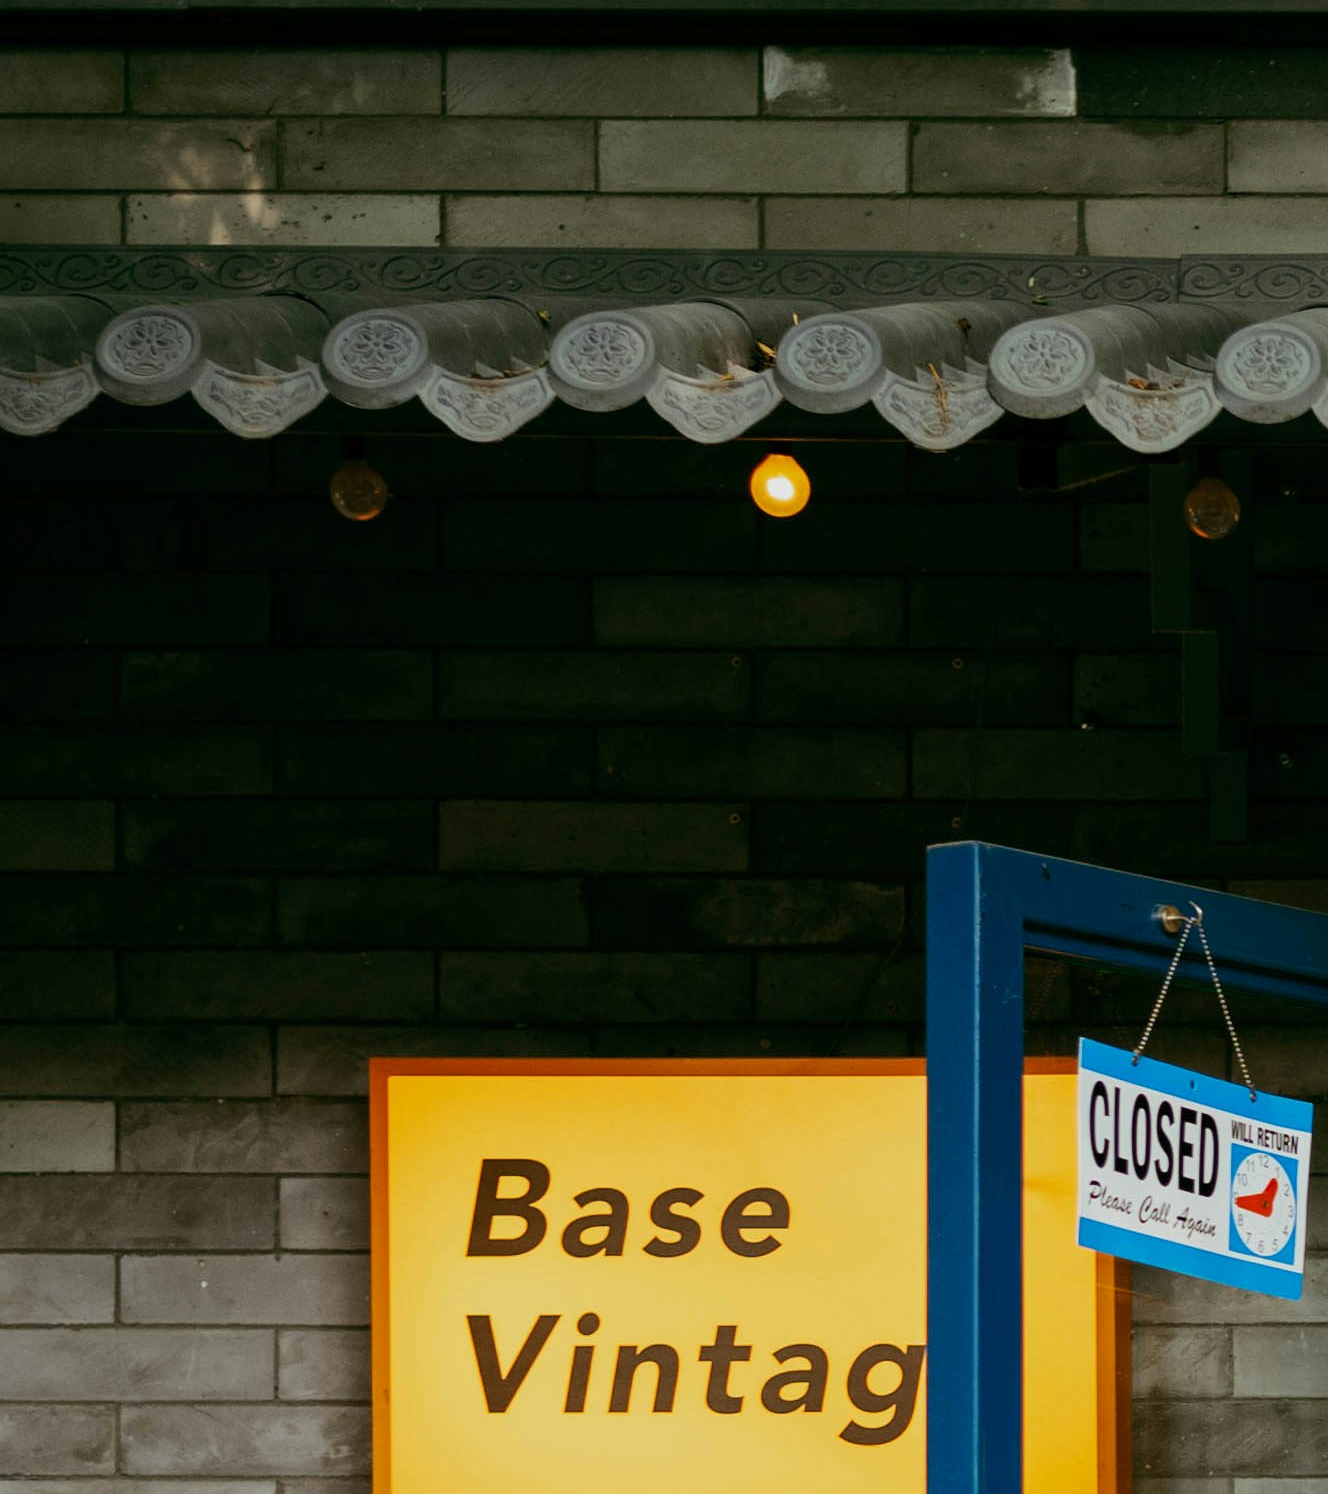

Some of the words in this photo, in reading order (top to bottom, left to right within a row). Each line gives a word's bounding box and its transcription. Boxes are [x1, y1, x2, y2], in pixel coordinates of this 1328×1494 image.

[1089, 1080, 1220, 1198] CLOSED
[1231, 1119, 1254, 1144] WILL
[1257, 1127, 1300, 1154] RETURN
[465, 1158, 791, 1258] Base
[1088, 1180, 1132, 1215] Please
[1138, 1195, 1170, 1224] Call
[1173, 1206, 1217, 1239] Again
[465, 1312, 927, 1447] Vintag
